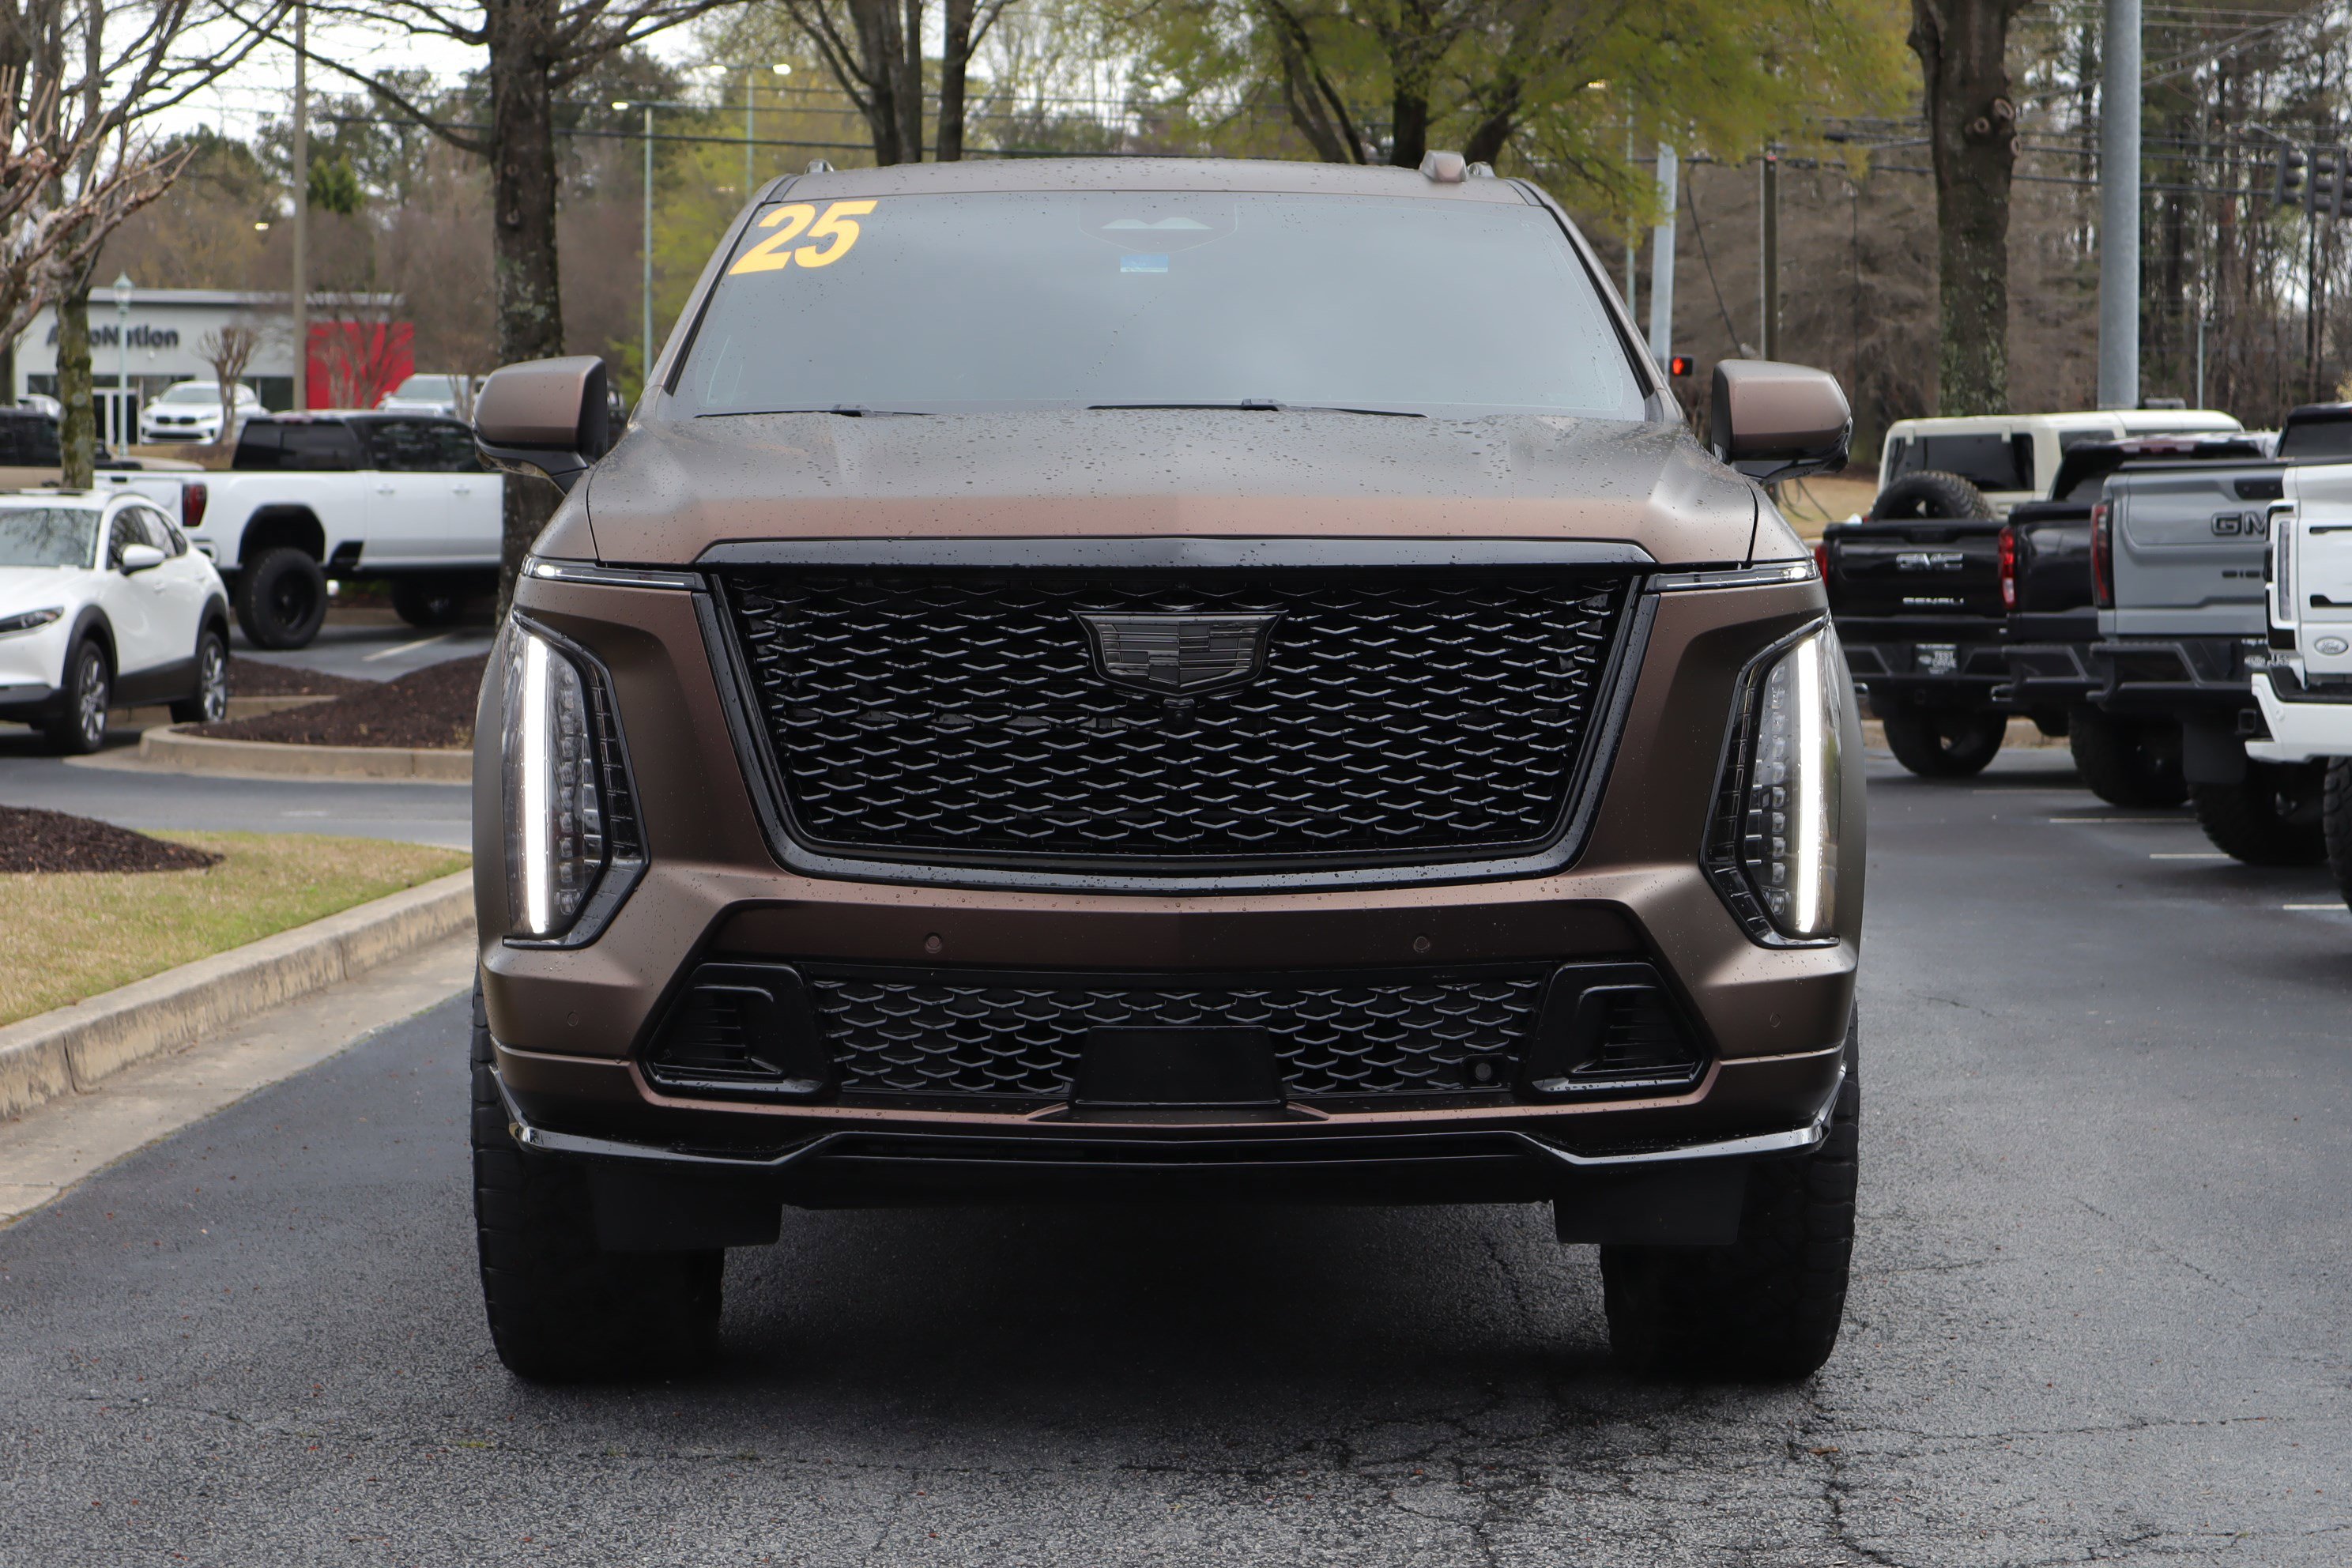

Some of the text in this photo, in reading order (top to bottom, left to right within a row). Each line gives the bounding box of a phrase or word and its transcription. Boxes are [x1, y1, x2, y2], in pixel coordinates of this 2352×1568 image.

[728, 200, 878, 275] 25
[2211, 512, 2267, 536] GM
[1896, 552, 1963, 570] GMC
